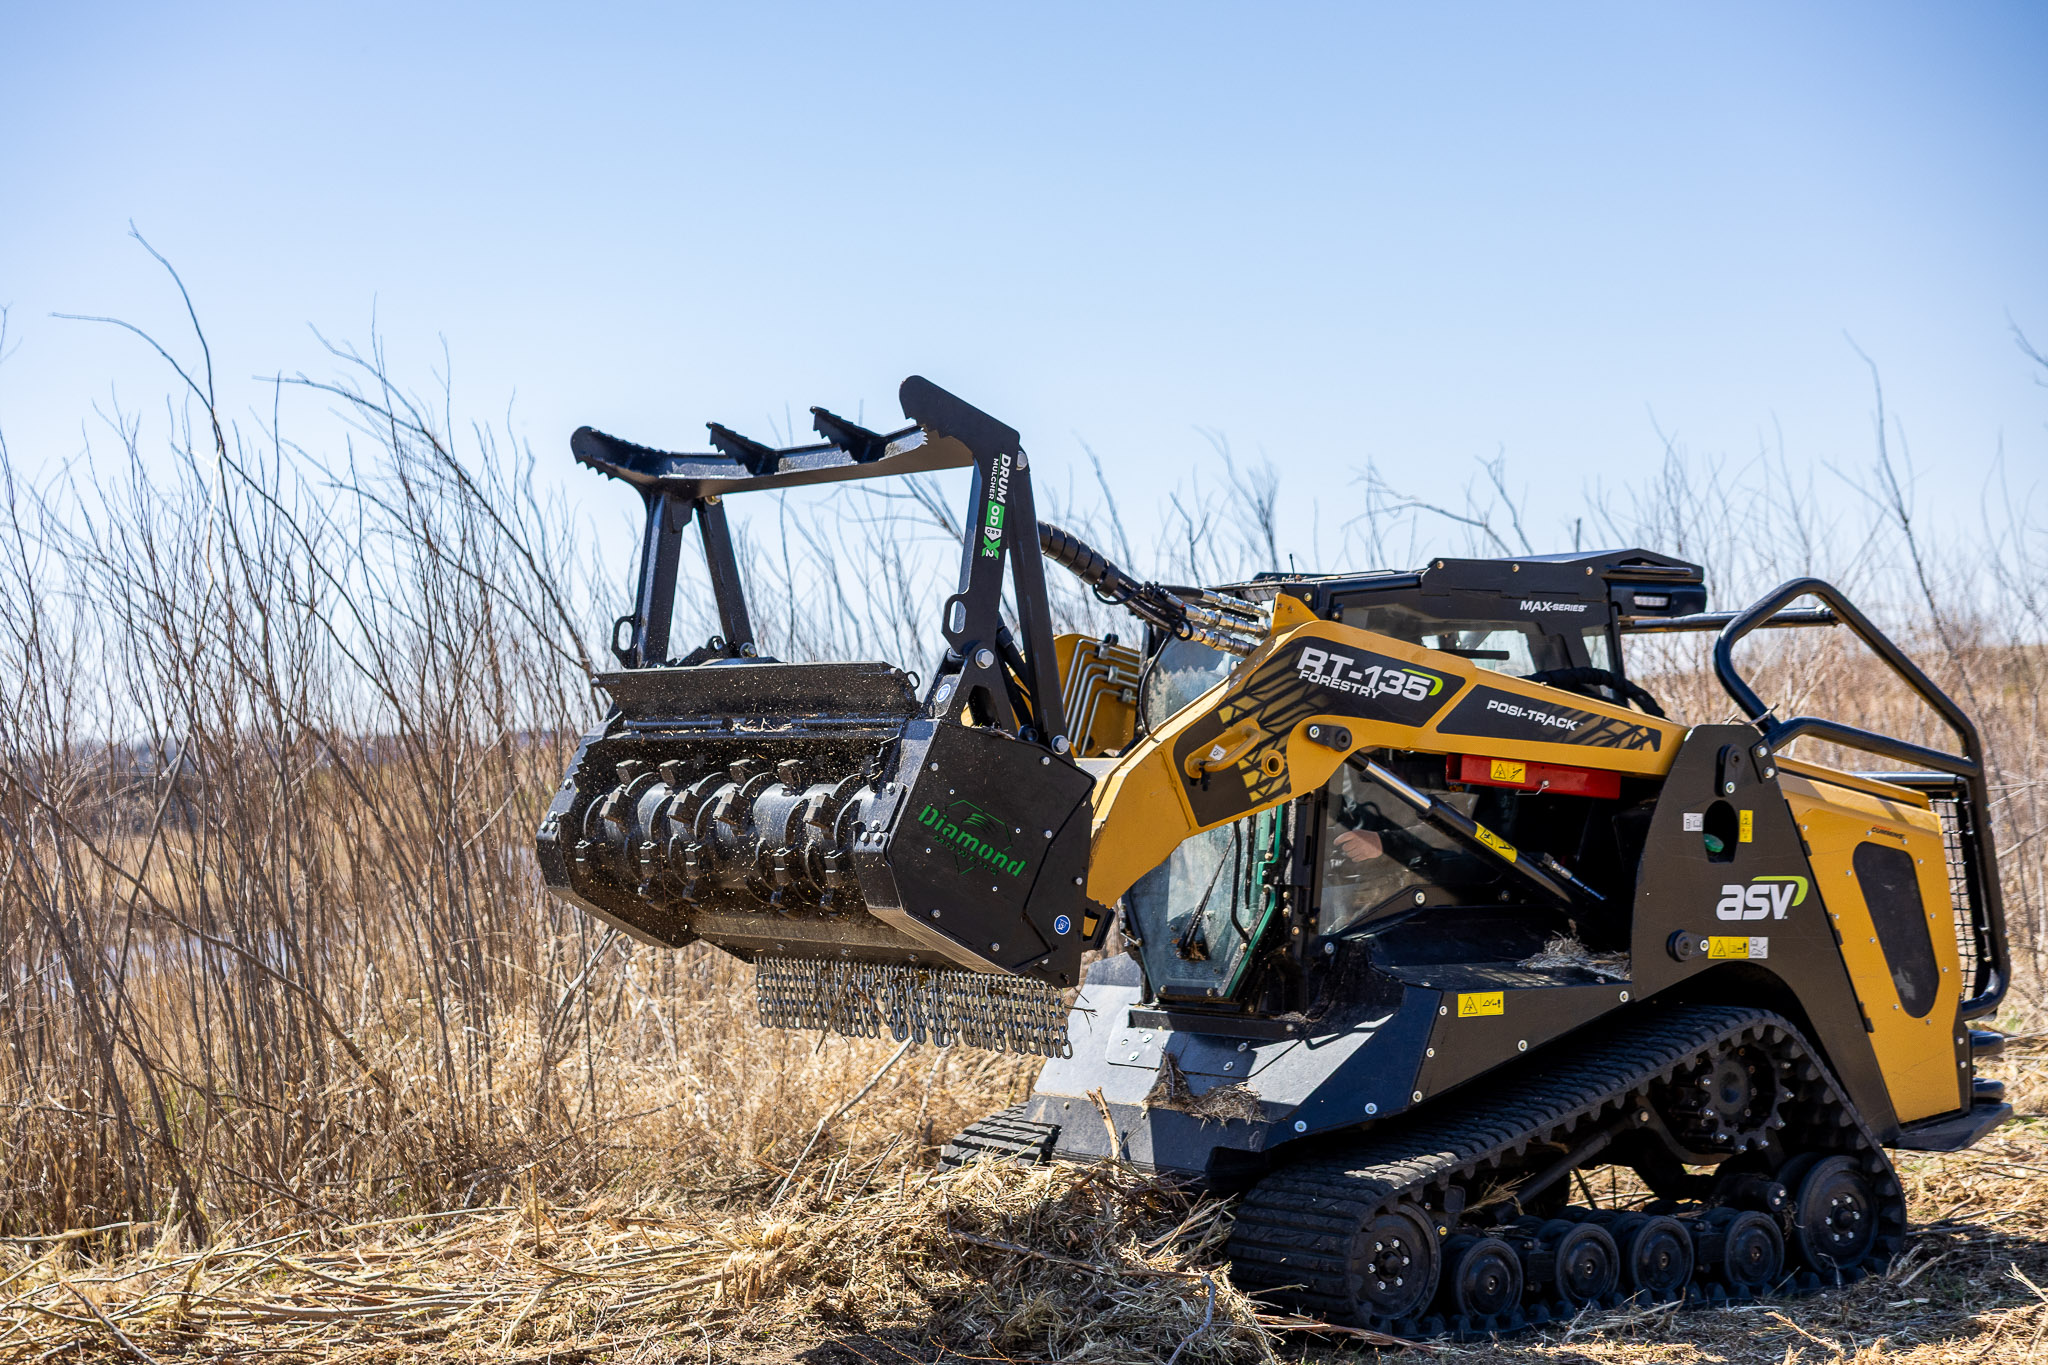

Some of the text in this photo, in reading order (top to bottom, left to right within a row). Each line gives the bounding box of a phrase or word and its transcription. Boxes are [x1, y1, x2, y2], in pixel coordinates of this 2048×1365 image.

[988, 458, 999, 500] MULCHER
[996, 453, 1012, 504] DRUM
[990, 505, 1000, 526] OD
[1296, 646, 1431, 702] RT-135
[1298, 670, 1383, 699] FORESTRY
[1486, 699, 1577, 732] POSI-TRACK
[917, 804, 1027, 878] Diamond
